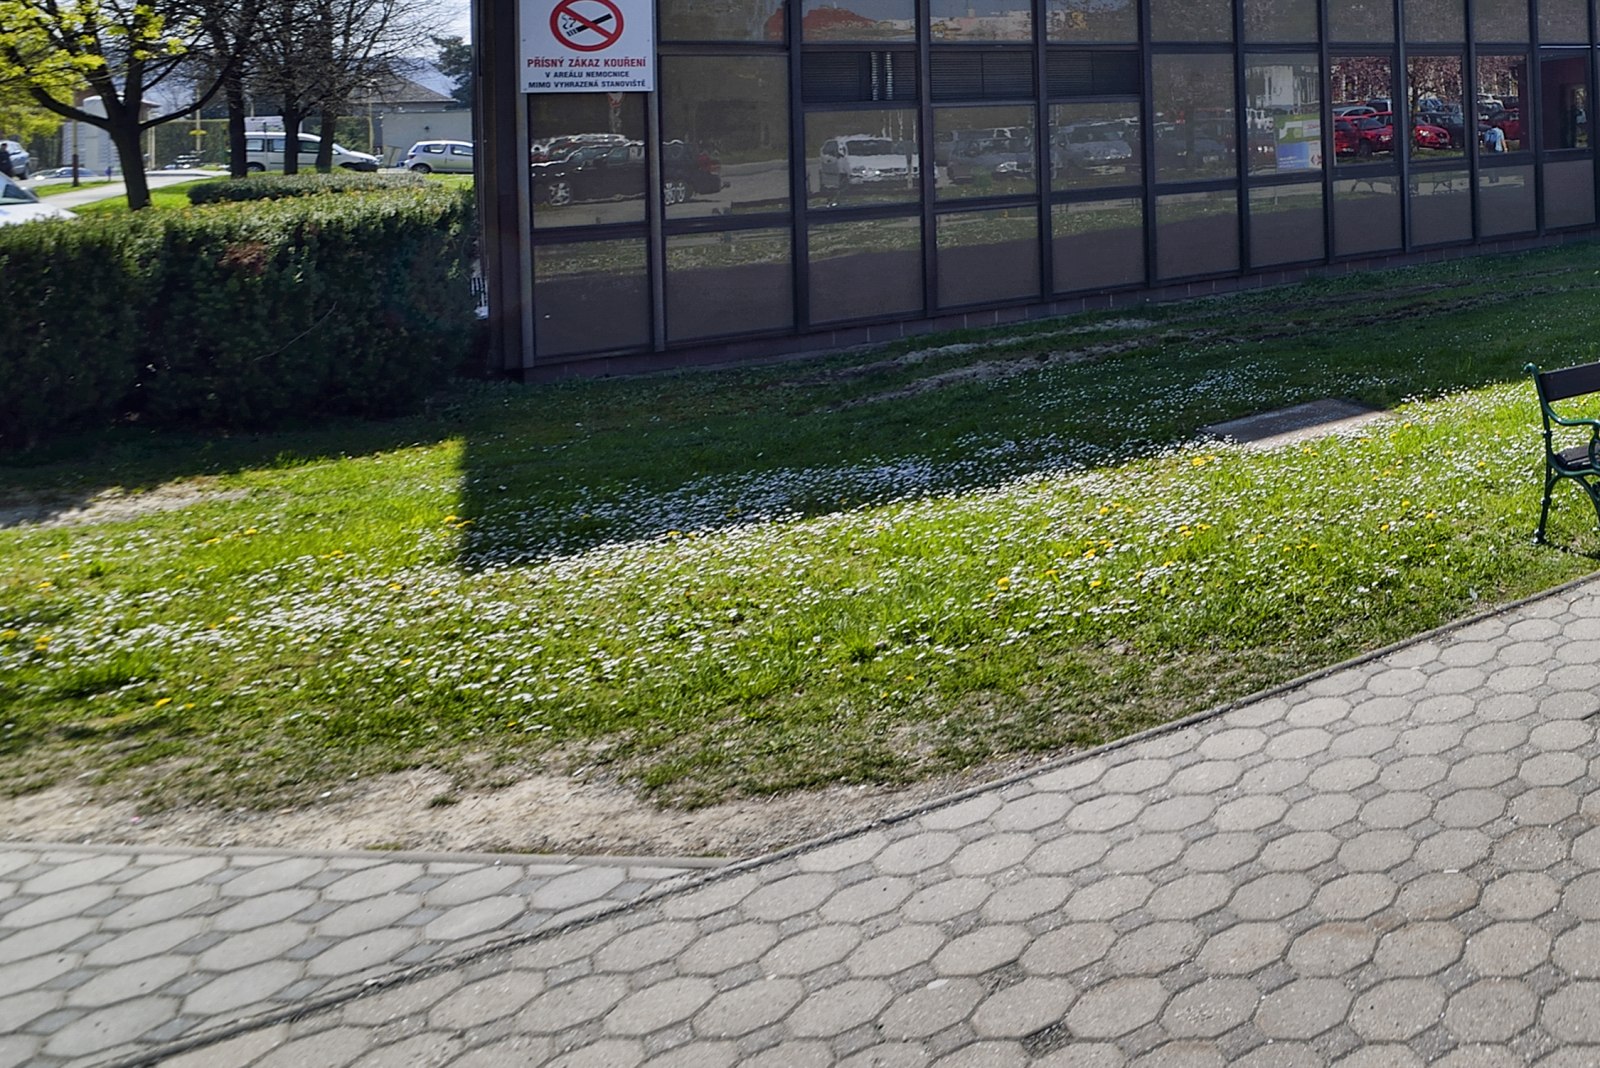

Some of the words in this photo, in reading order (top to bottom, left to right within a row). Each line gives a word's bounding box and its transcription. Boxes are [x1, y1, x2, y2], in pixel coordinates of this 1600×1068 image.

[526, 56, 565, 68] PŘÍSNÝ
[568, 56, 601, 68] ZÁKAZ
[603, 55, 647, 68] KOUŘENÍ
[544, 71, 551, 79] V
[553, 70, 583, 79] AREÁLU
[585, 70, 630, 78] NEMOCNICE
[553, 80, 599, 88] VYHRAZENÁ
